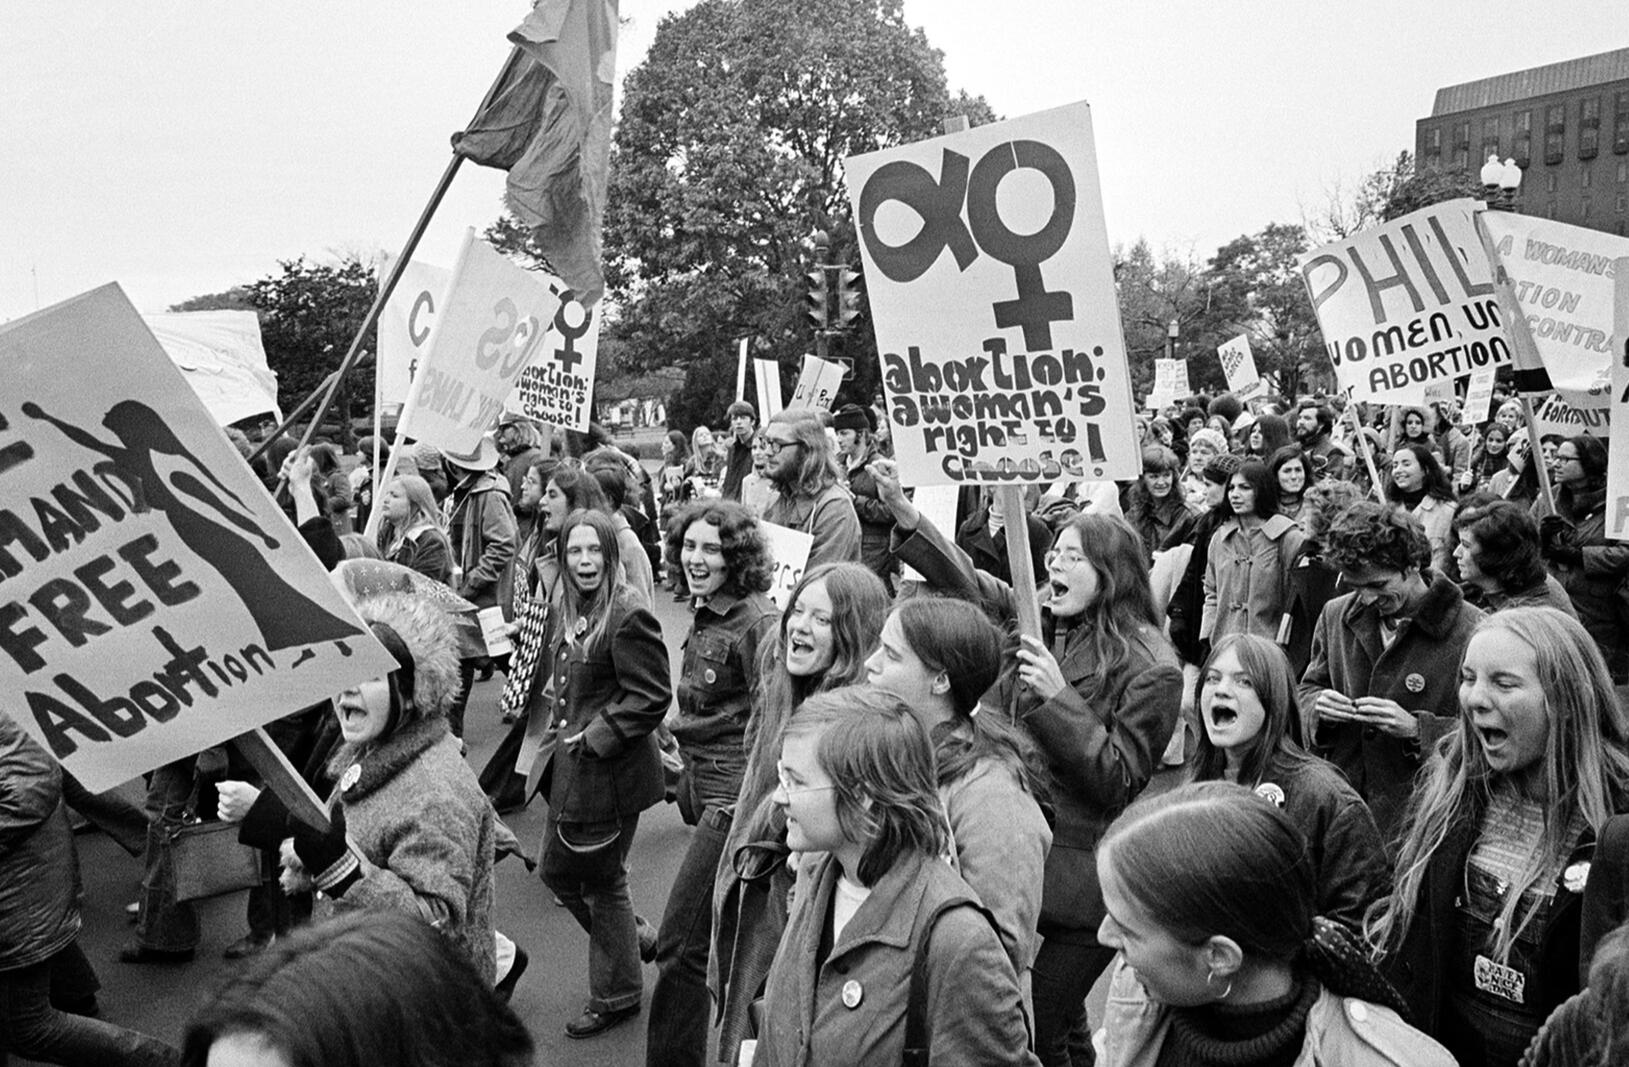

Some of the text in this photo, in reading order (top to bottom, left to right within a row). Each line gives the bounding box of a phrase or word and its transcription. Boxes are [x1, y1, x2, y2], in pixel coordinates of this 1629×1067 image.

[1302, 215, 1496, 326] PHIL
[1497, 235, 1513, 256] A
[883, 337, 1106, 395] abortion:
[1369, 336, 1512, 393] ABORTION
[519, 390, 573, 412] right to
[920, 384, 1107, 426] woman's
[923, 417, 1077, 458] right to
[0, 461, 153, 582] MAND
[0, 533, 202, 675] FREE
[24, 625, 276, 760] Abortion
